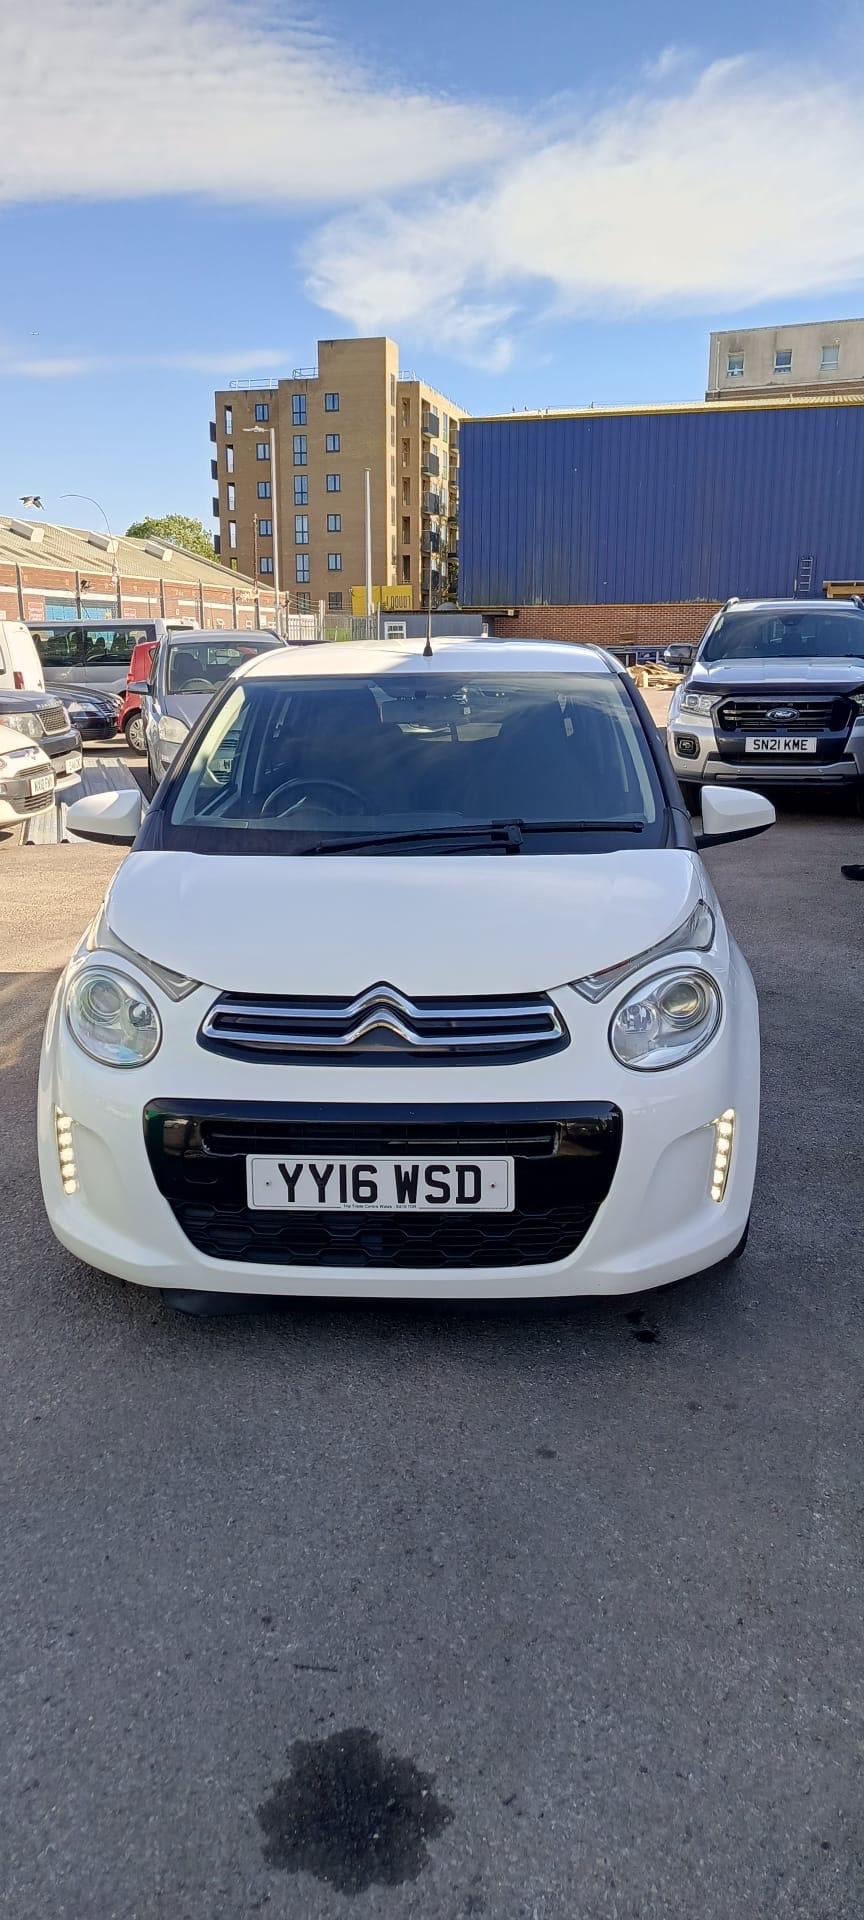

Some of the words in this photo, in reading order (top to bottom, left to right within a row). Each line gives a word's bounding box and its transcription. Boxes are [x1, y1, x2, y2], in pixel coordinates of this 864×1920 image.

[753, 739, 781, 750] SN21
[784, 739, 809, 750] KME
[277, 1163, 378, 1204] YY16
[393, 1164, 482, 1204] WSD
